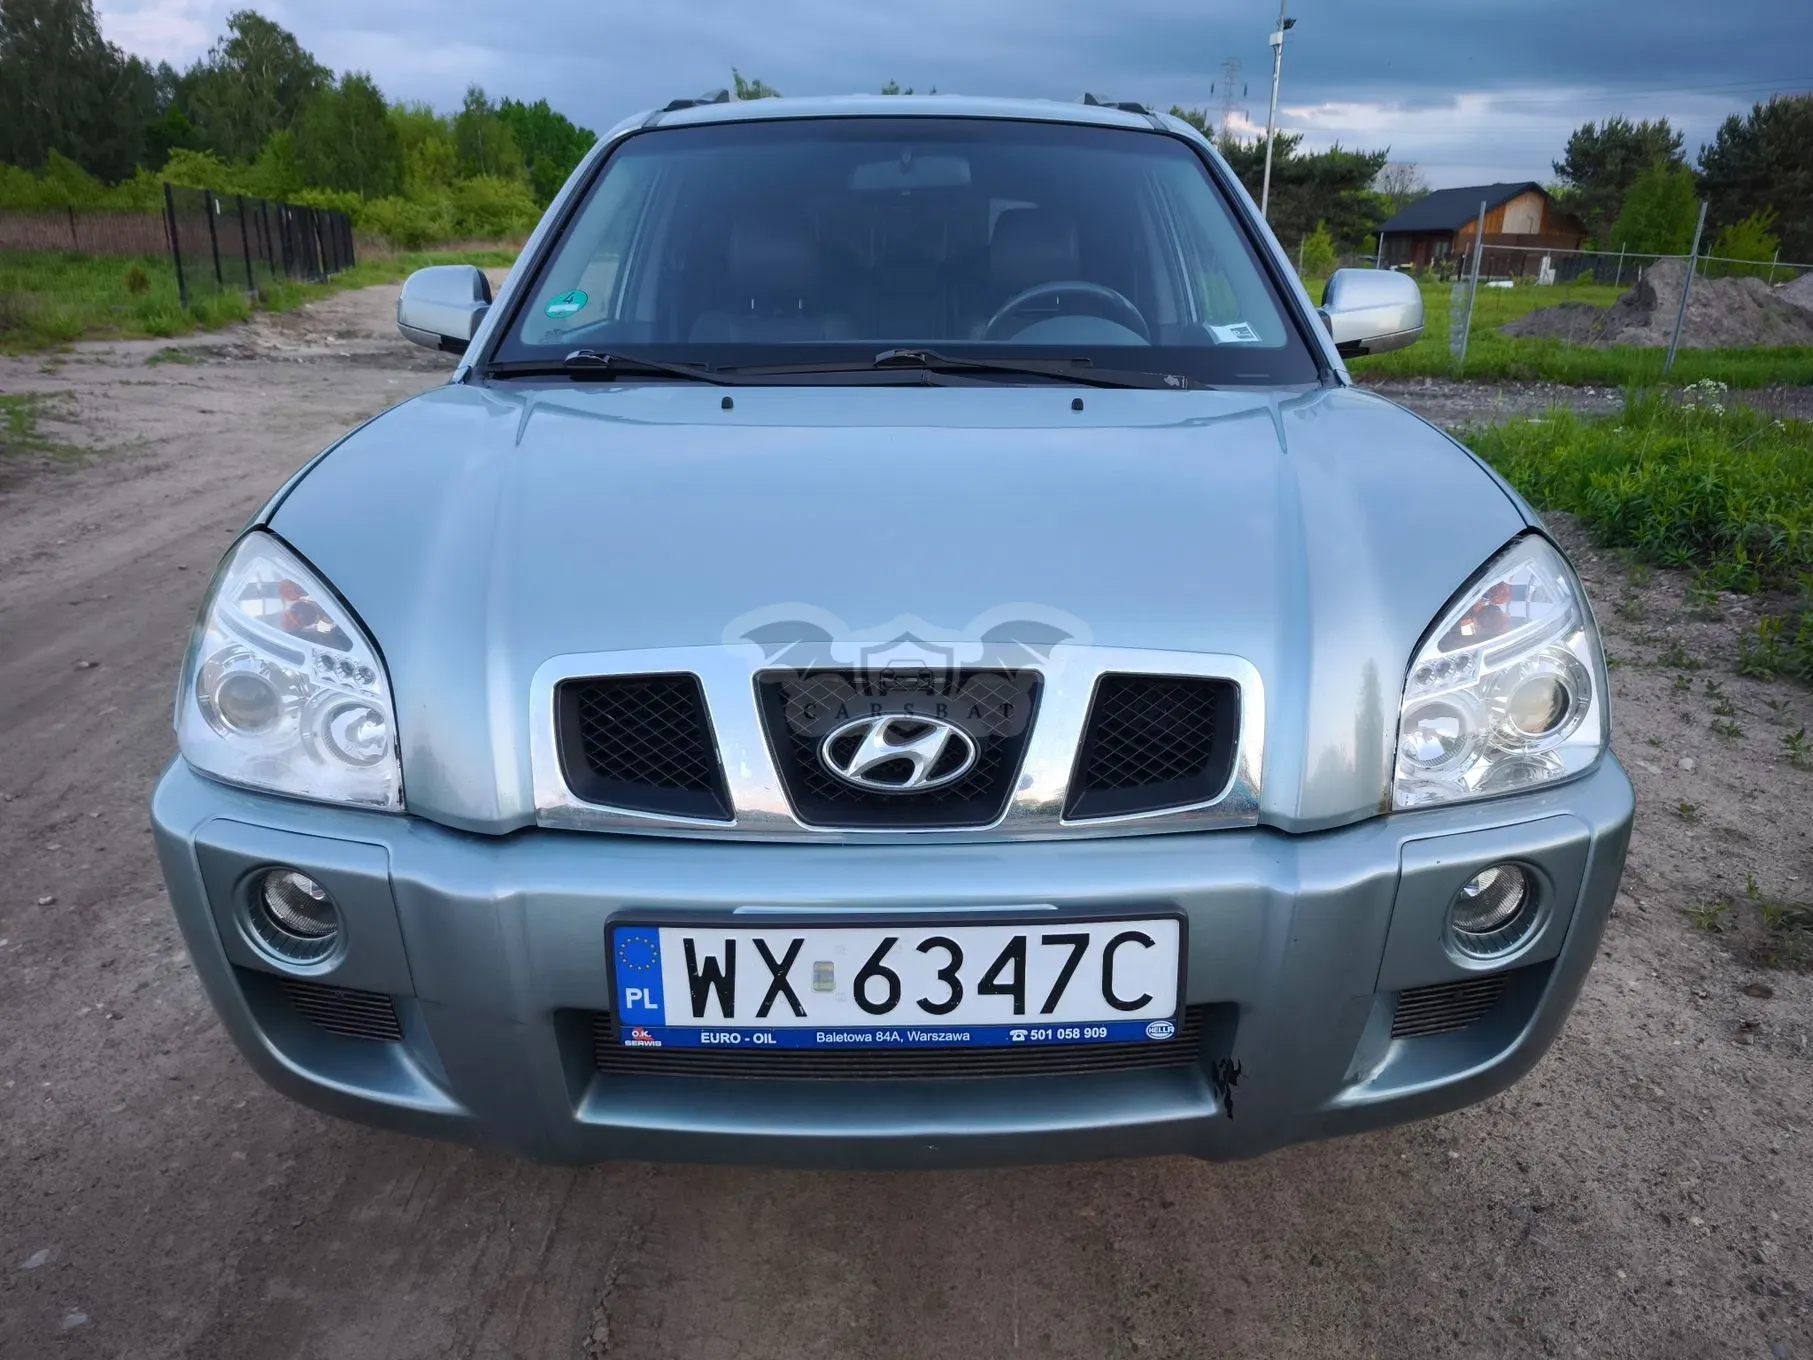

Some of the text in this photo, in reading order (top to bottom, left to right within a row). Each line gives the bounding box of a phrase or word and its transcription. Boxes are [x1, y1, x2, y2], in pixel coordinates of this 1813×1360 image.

[562, 291, 576, 304] 4
[682, 930, 1156, 1018] WX 6347C
[625, 988, 658, 1009] PL
[816, 1030, 971, 1043] Baletowa 84A, Warszawa
[1030, 1027, 1108, 1041] 501 058 909
[1148, 1026, 1175, 1035] HELLA
[701, 1032, 741, 1044] EURO
[752, 1032, 777, 1044] OIL
